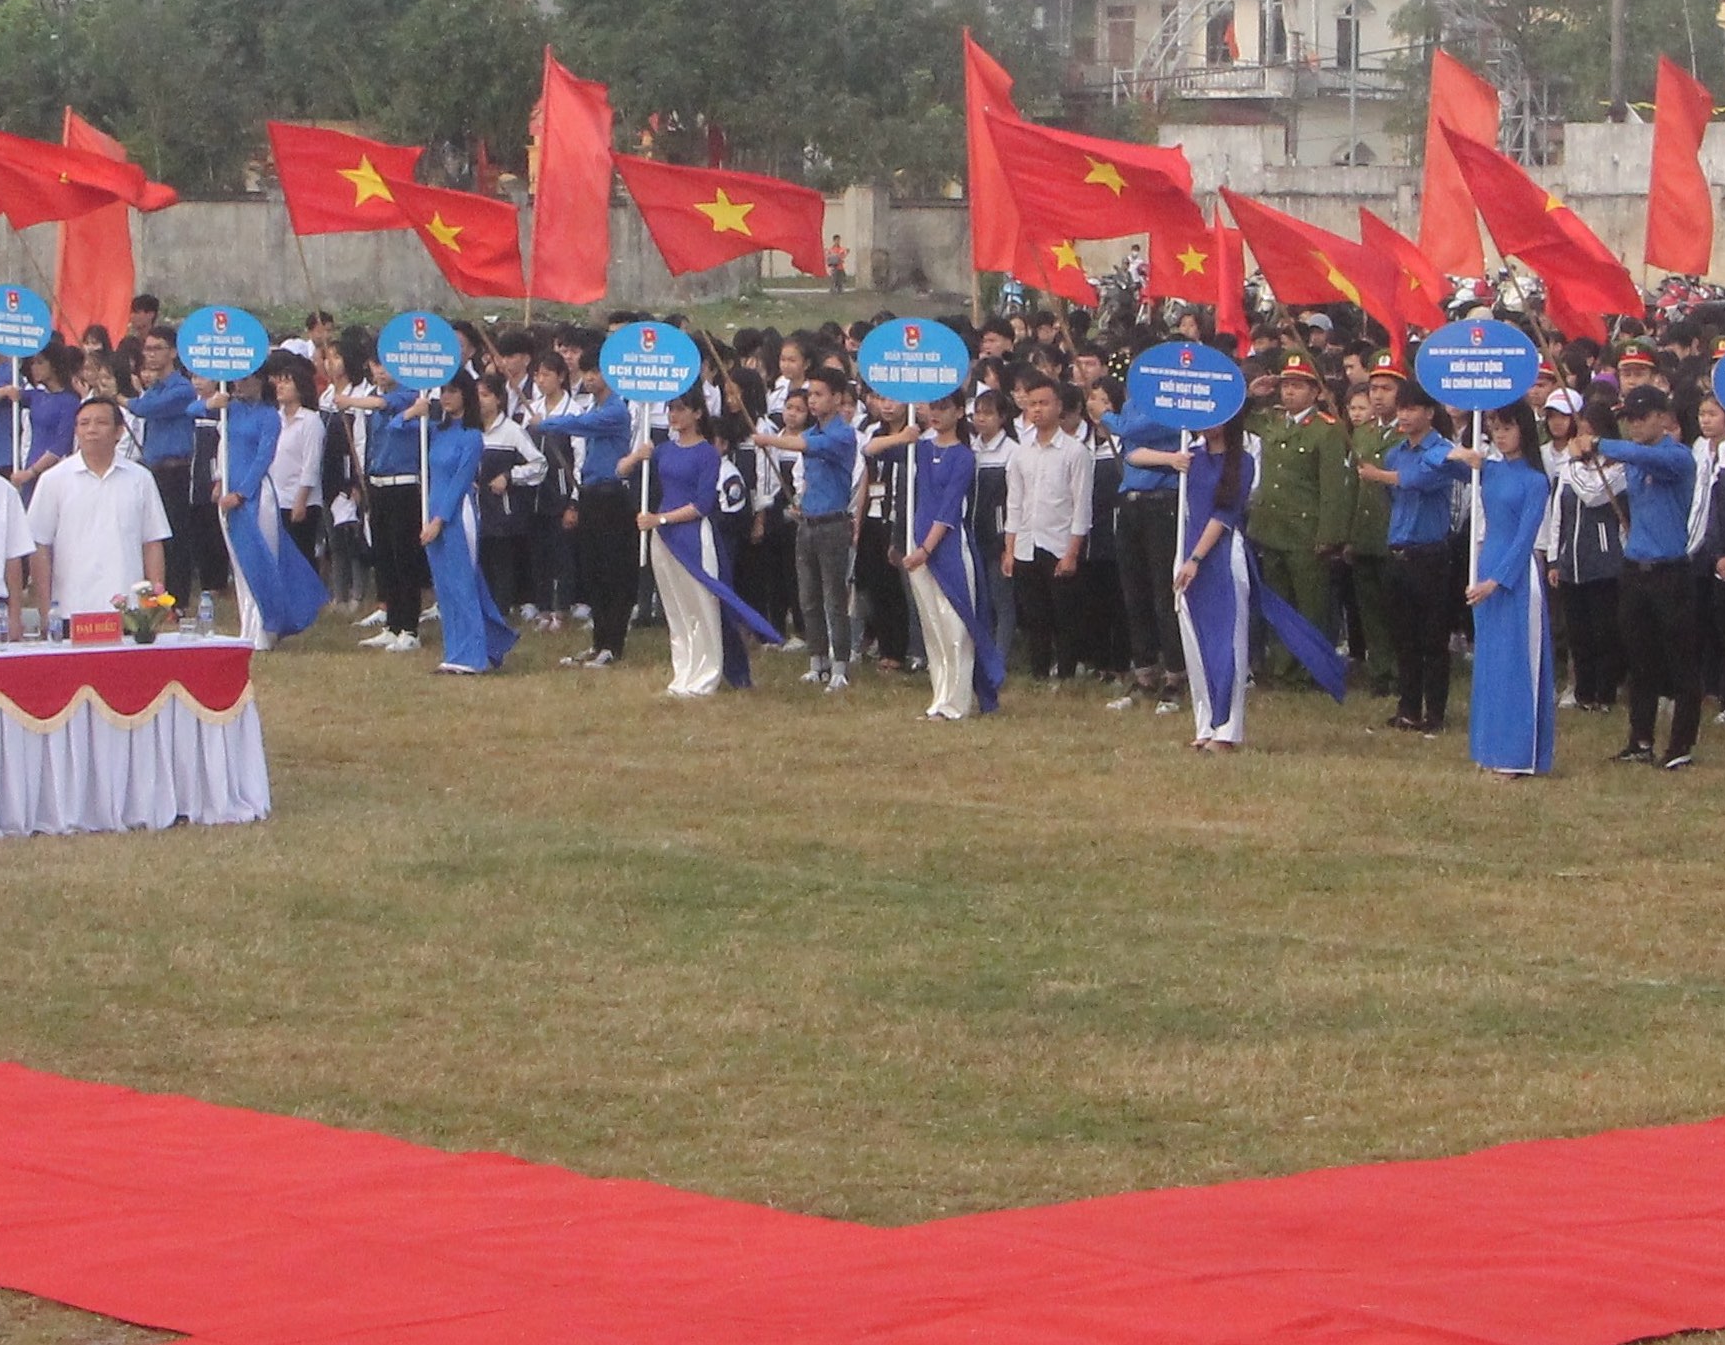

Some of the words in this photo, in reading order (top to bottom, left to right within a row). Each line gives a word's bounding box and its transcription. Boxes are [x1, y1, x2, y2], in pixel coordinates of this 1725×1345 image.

[608, 364, 632, 376] BCH
[635, 364, 668, 378] QUÂN
[671, 366, 689, 380] SỰ
